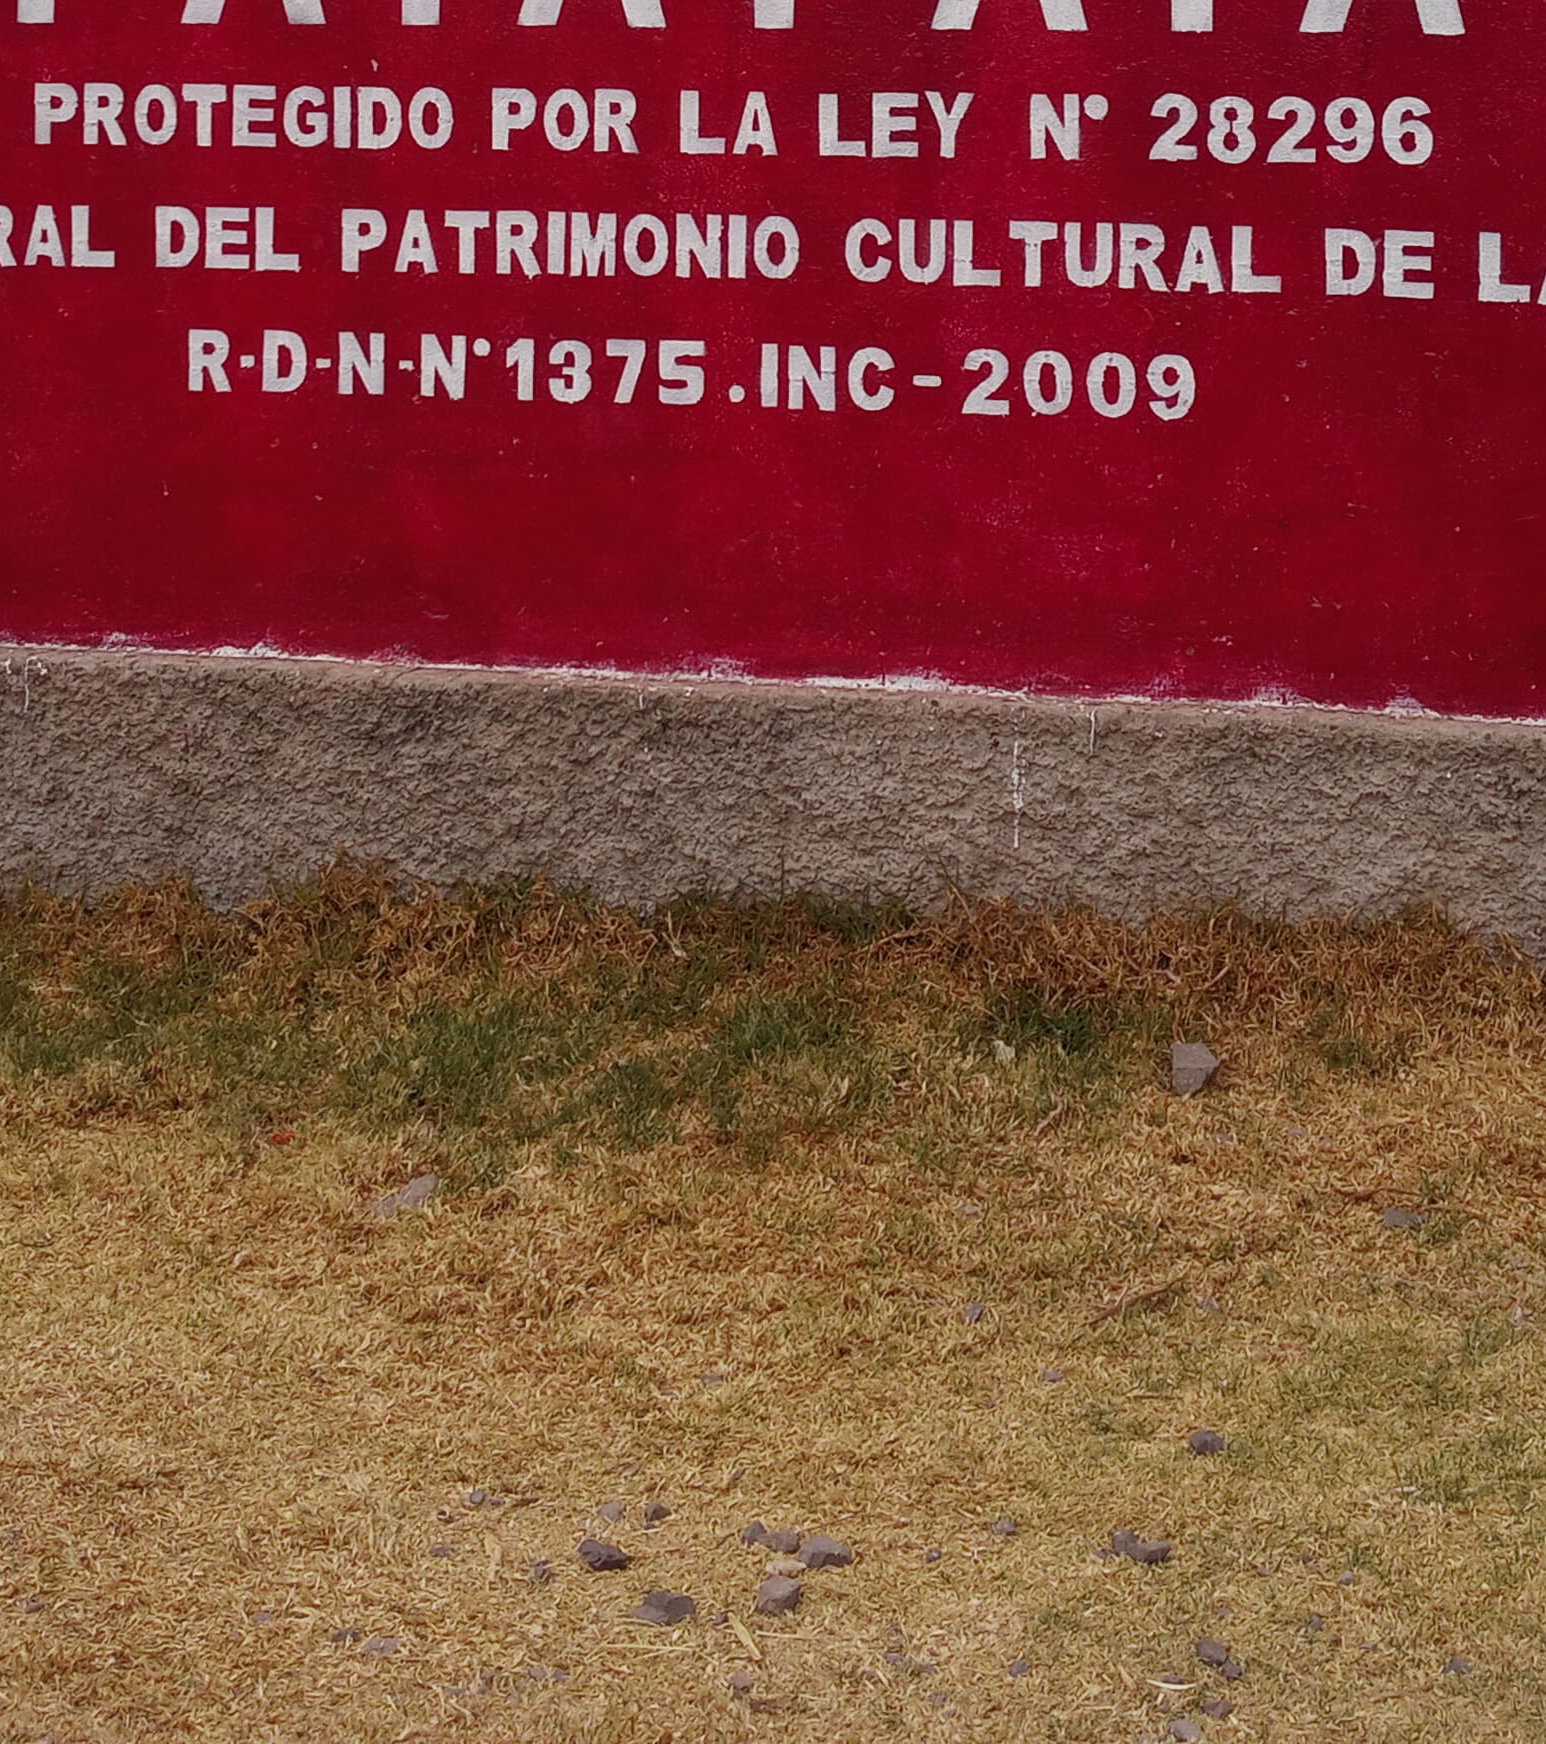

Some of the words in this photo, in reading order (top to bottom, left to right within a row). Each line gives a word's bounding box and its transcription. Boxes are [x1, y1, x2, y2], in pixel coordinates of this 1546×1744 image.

[33, 82, 454, 150] PROTEGIDO
[491, 87, 639, 154] POR
[679, 89, 778, 157] LA
[818, 90, 975, 161] LEY
[1148, 92, 1434, 166] 28296
[155, 205, 302, 273] DEL
[341, 208, 800, 280] PATRIMONIO
[844, 217, 1282, 295] CULTURAL
[1324, 227, 1435, 300] DE
